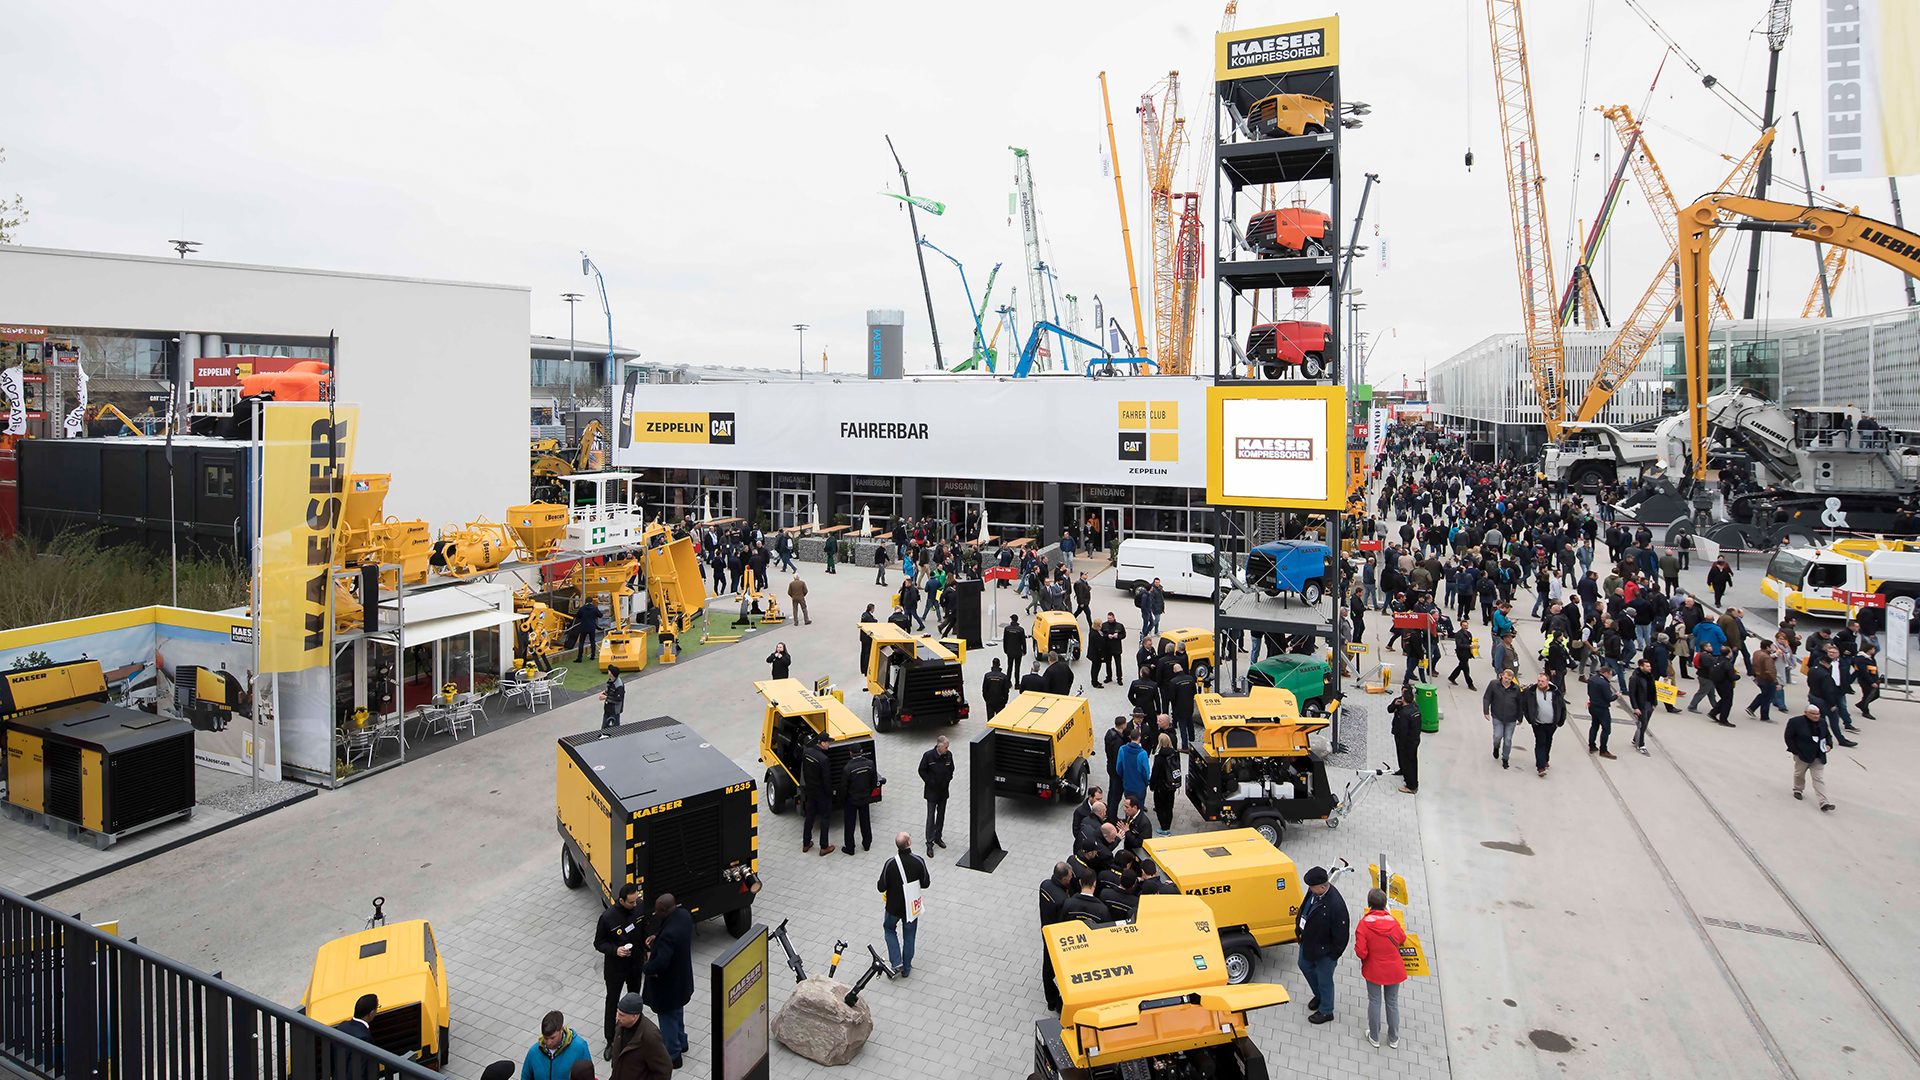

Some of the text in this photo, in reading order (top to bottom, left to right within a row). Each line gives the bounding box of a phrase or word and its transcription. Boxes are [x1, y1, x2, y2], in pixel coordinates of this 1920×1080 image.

[1231, 32, 1320, 57] KAESER
[1231, 46, 1320, 67] KOMPRESSOREN
[1859, 226, 1920, 264] LIEBH
[873, 329, 881, 376] SIMEM
[198, 367, 231, 377] ZEPPELIN
[1122, 410, 1166, 420] FAHRER CLUB
[646, 420, 733, 436] ZEPPELIN CAT
[840, 422, 929, 439] FAHRERBAR
[1750, 420, 1788, 443] LIEBHERR
[1124, 441, 1142, 452] CAT
[1238, 439, 1310, 451] KAESER
[1238, 450, 1310, 459] KOMPRESSOREN
[1129, 467, 1168, 475] ZEPPELIN
[855, 478, 890, 488] FAHRERBAR
[944, 482, 978, 491] AUSGANG
[1090, 487, 1126, 497] EINGANG
[304, 418, 347, 651] KAESER
[233, 627, 253, 636] KAES
[12, 673, 47, 684] KAESER
[1056, 718, 1075, 742] KAESER
[195, 755, 230, 767] www.kaeser.com
[725, 782, 751, 795] M 235
[590, 789, 612, 818] KAESER
[633, 800, 683, 820] KAESER
[1185, 885, 1232, 896] KAESER
[1124, 925, 1139, 933] 185
[1059, 934, 1087, 946] M 55
[1063, 943, 1089, 952] MOBILAIR
[730, 963, 761, 998] KAESER
[1070, 964, 1134, 985] KAESER
